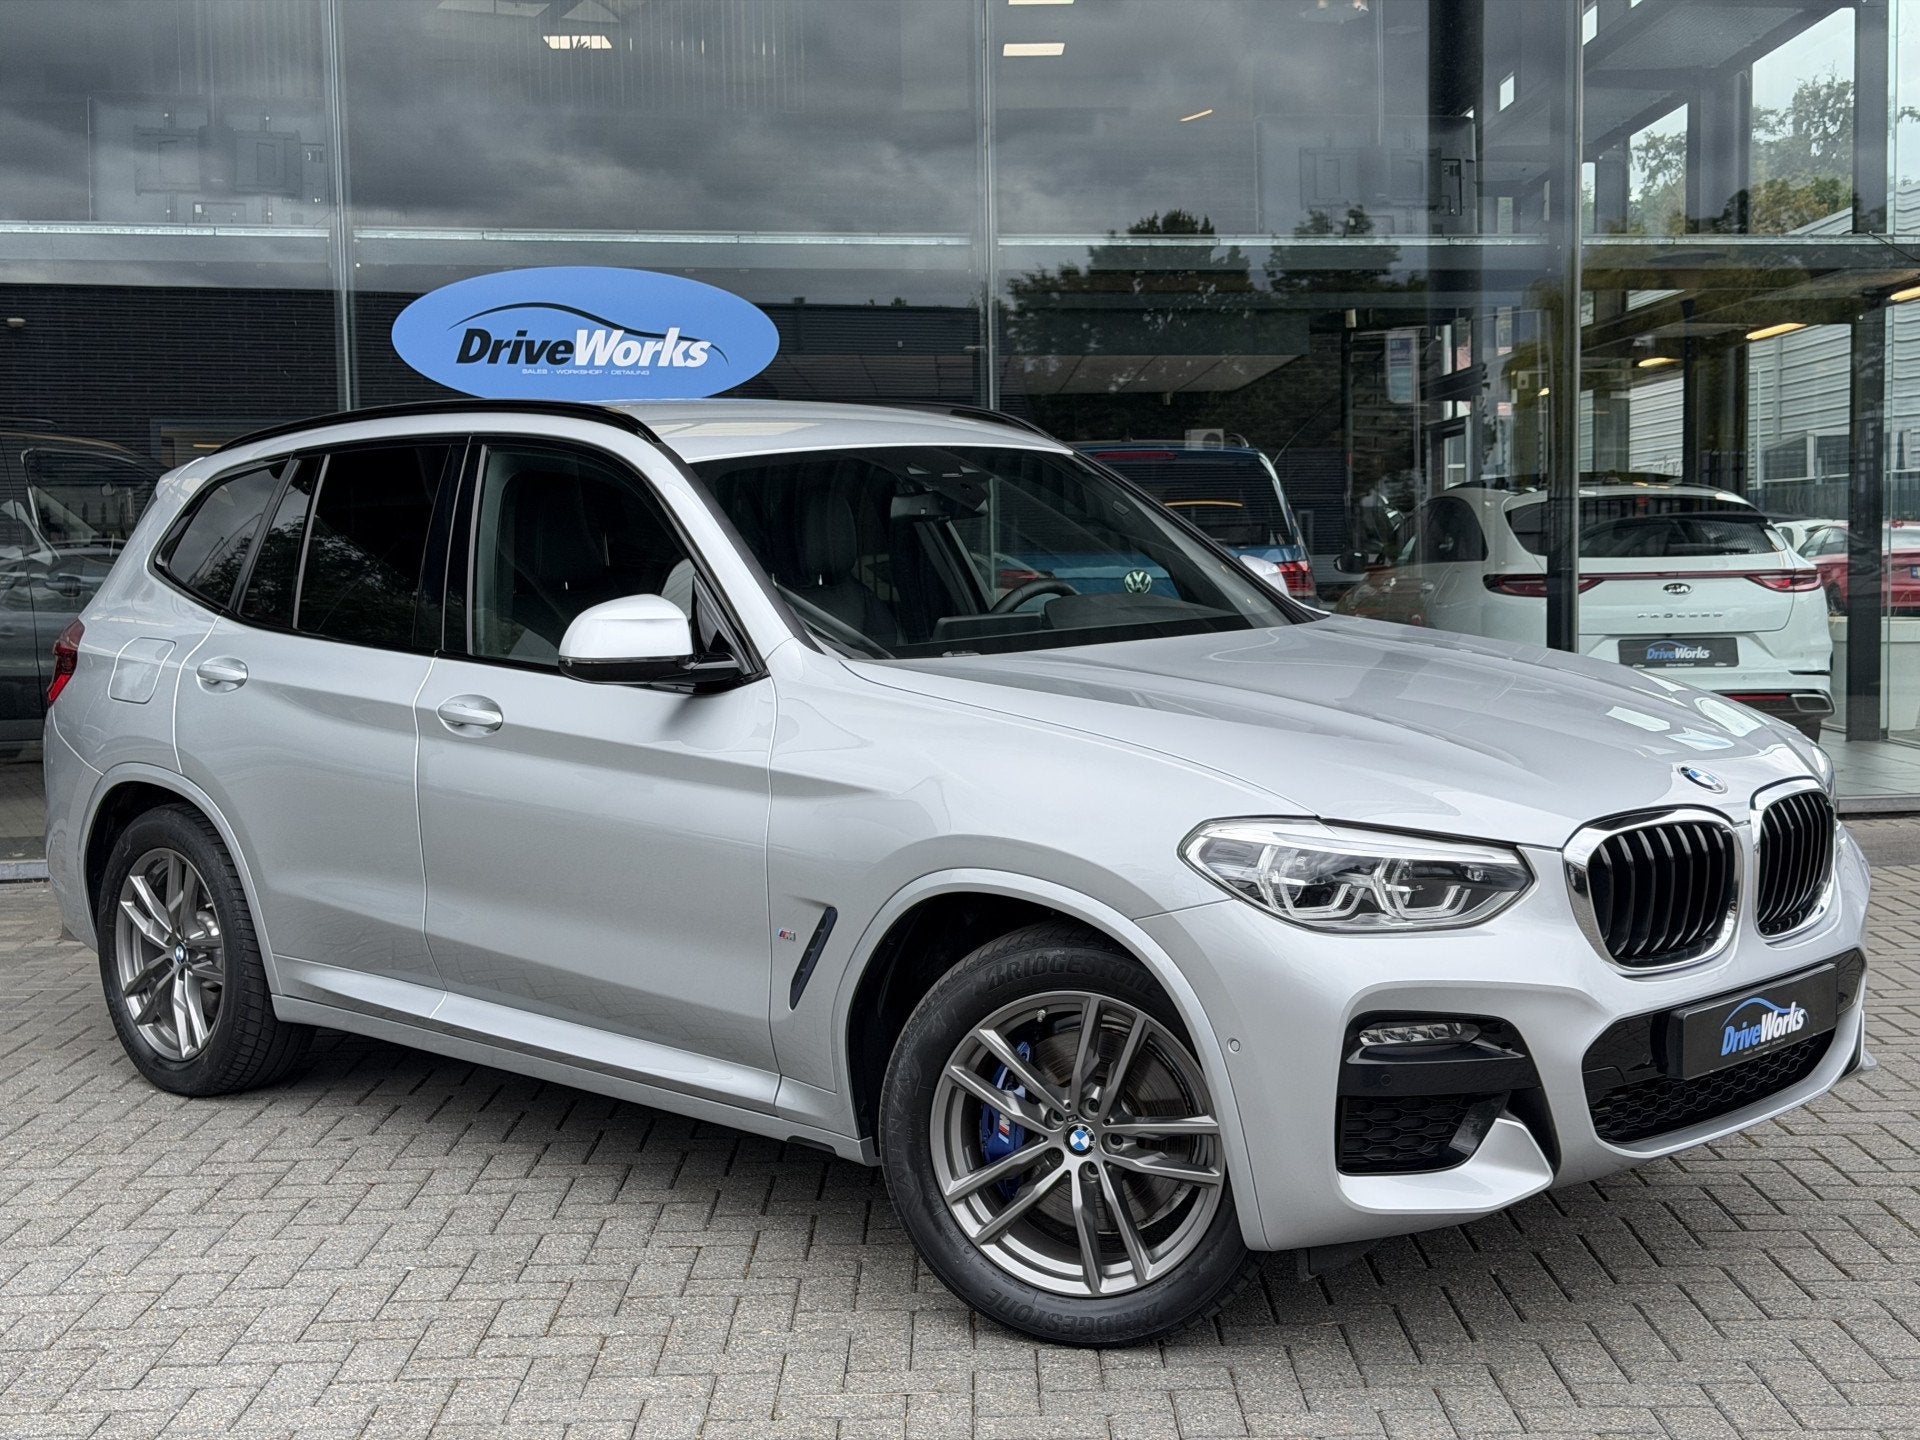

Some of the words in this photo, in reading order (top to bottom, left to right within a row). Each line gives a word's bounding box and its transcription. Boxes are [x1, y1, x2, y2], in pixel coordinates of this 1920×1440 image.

[456, 327, 712, 368] DriveWorks
[1646, 646, 1711, 660] DriveWorks
[1721, 1001, 1805, 1057] DriveWorks
